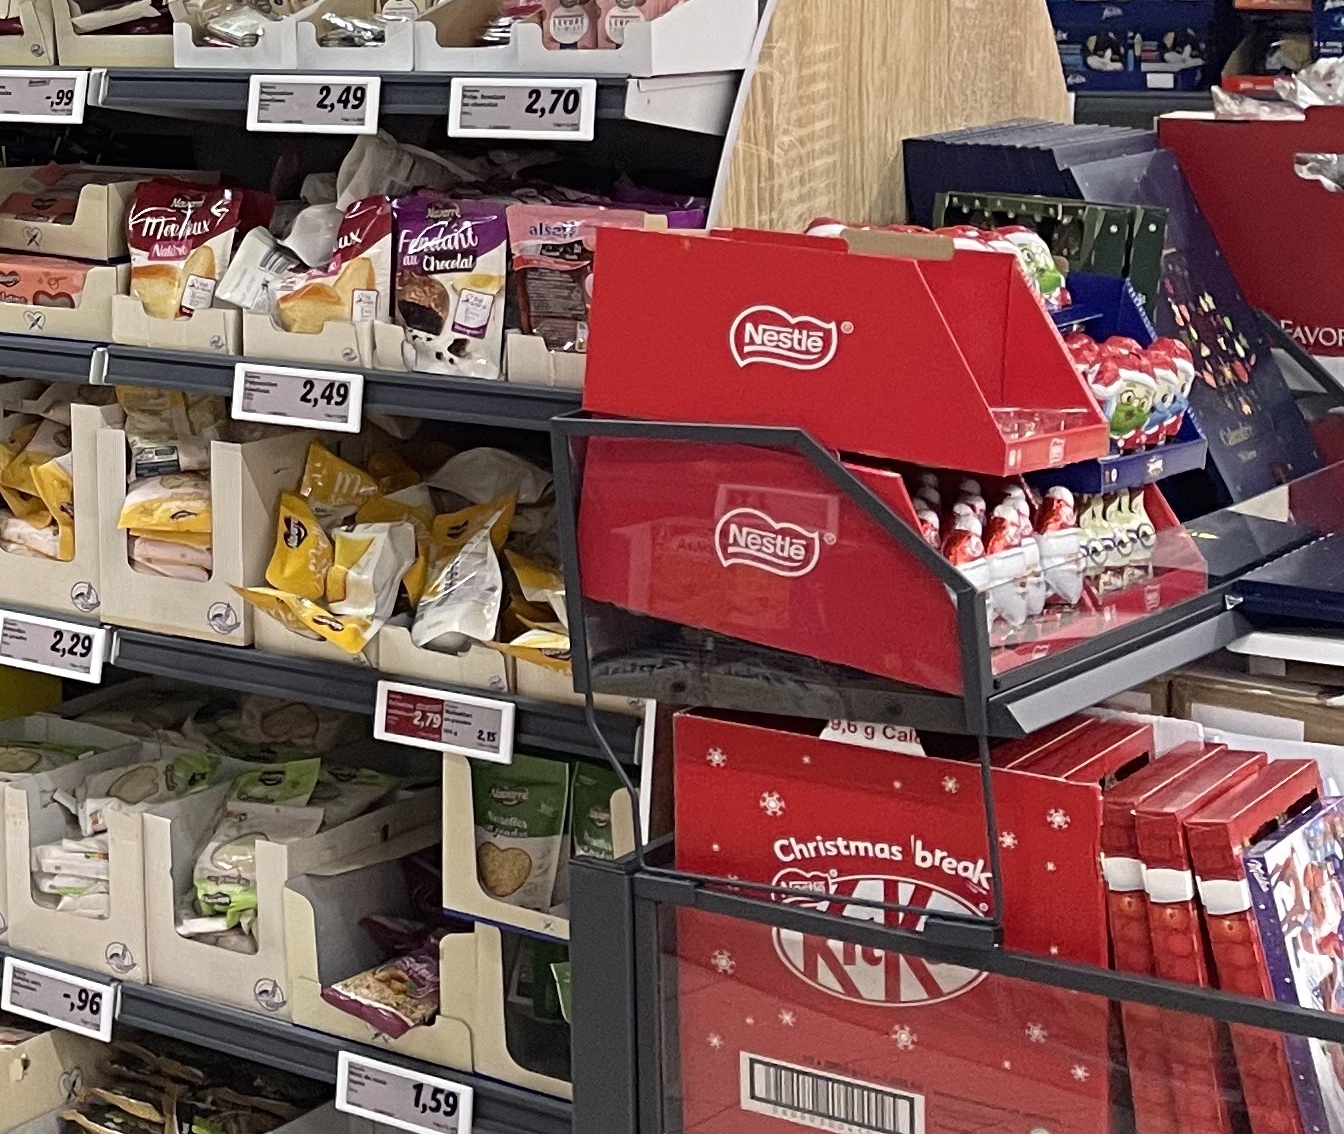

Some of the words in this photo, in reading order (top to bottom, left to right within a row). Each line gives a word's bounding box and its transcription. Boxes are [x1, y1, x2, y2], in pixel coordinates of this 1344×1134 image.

[45, 89, 74, 108] -,99
[316, 85, 366, 113] 2,49
[525, 89, 581, 118] 2,70
[744, 322, 824, 353] Nestlé
[300, 379, 349, 408] 2,49
[728, 527, 806, 561] Nestlé
[50, 629, 92, 658] 2,29
[864, 727, 875, 739] g
[774, 835, 903, 863] Christmas
[915, 839, 993, 890] break
[62, 987, 103, 1015] -,96
[412, 1082, 459, 1117] 1,59
